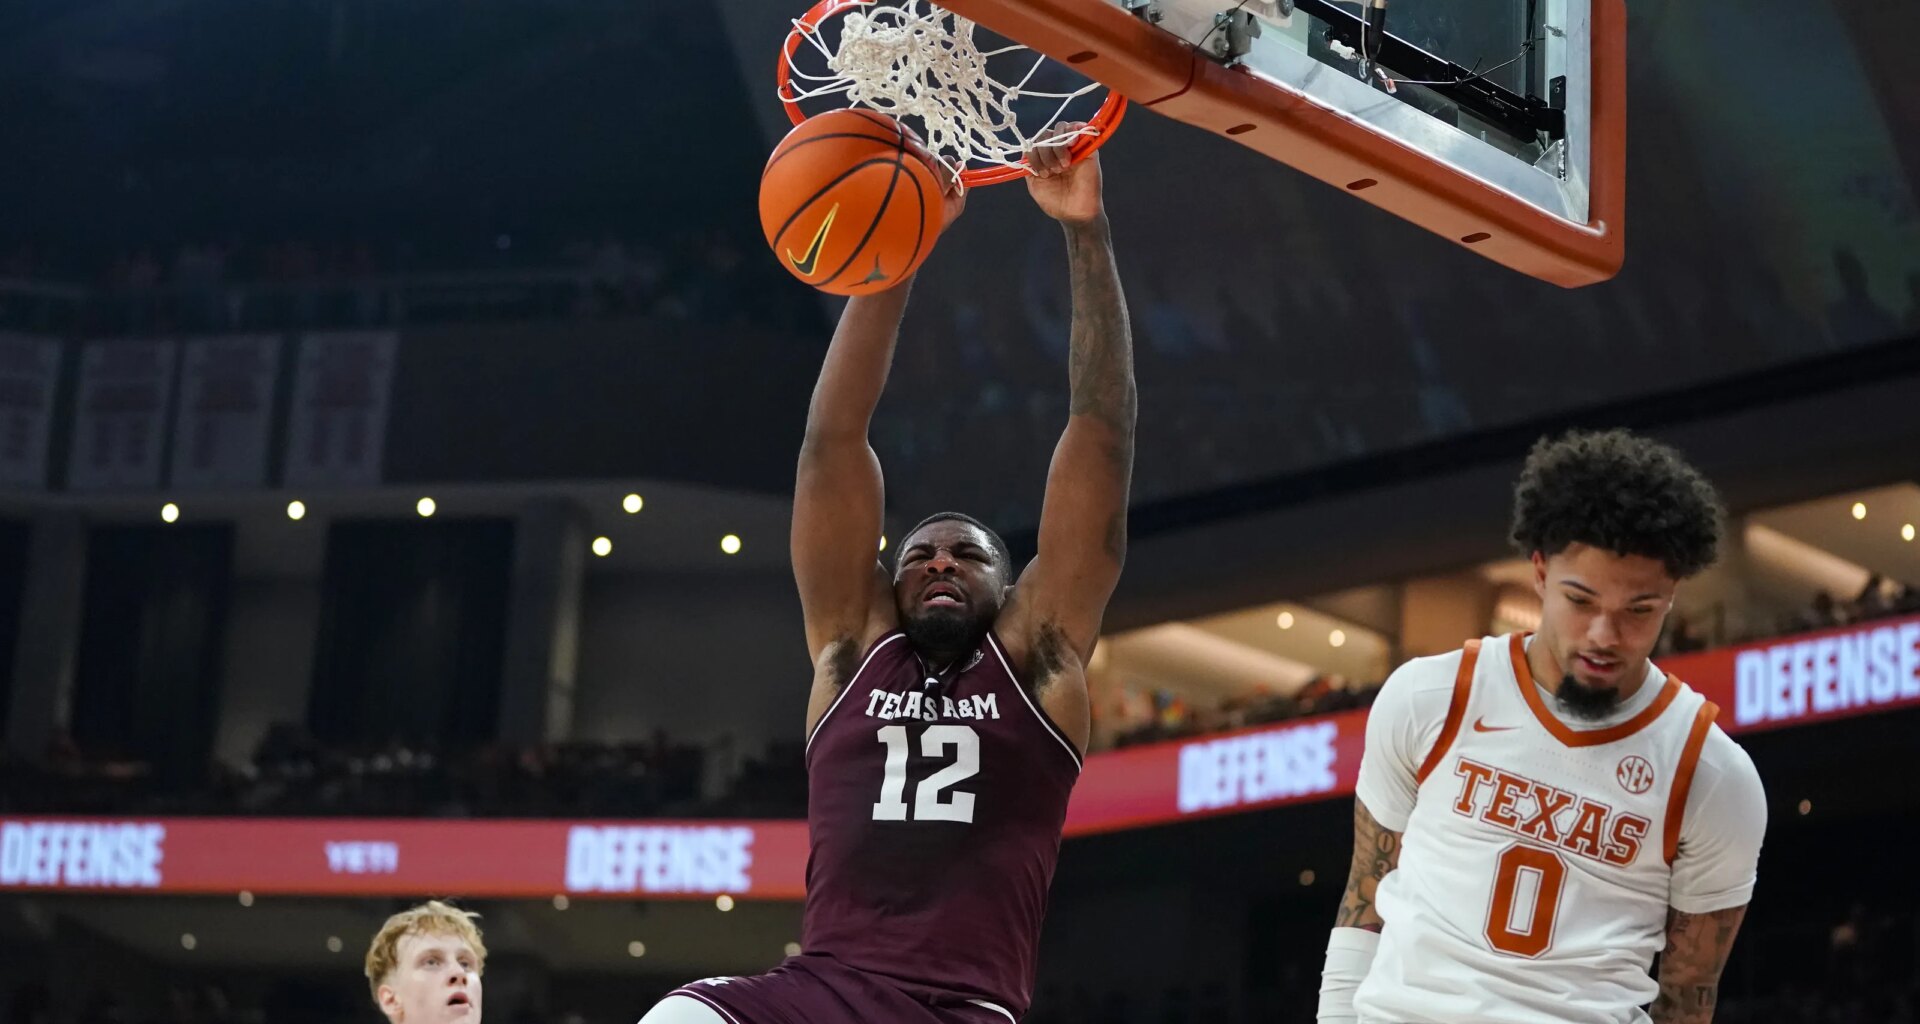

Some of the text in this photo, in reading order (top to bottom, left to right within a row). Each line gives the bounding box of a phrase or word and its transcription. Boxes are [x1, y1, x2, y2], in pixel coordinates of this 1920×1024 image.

[941, 692, 1000, 720] A&M
[1735, 621, 1920, 727] DEFENSE
[872, 725, 980, 823] 12
[1176, 719, 1339, 814] DEFENSE
[1617, 755, 1654, 794] SEC
[1452, 756, 1652, 868] TEXAS
[0, 821, 165, 888] DEFENSE
[322, 840, 399, 874] YETI
[565, 825, 755, 892] DEFENSE
[1482, 841, 1569, 960] 0
